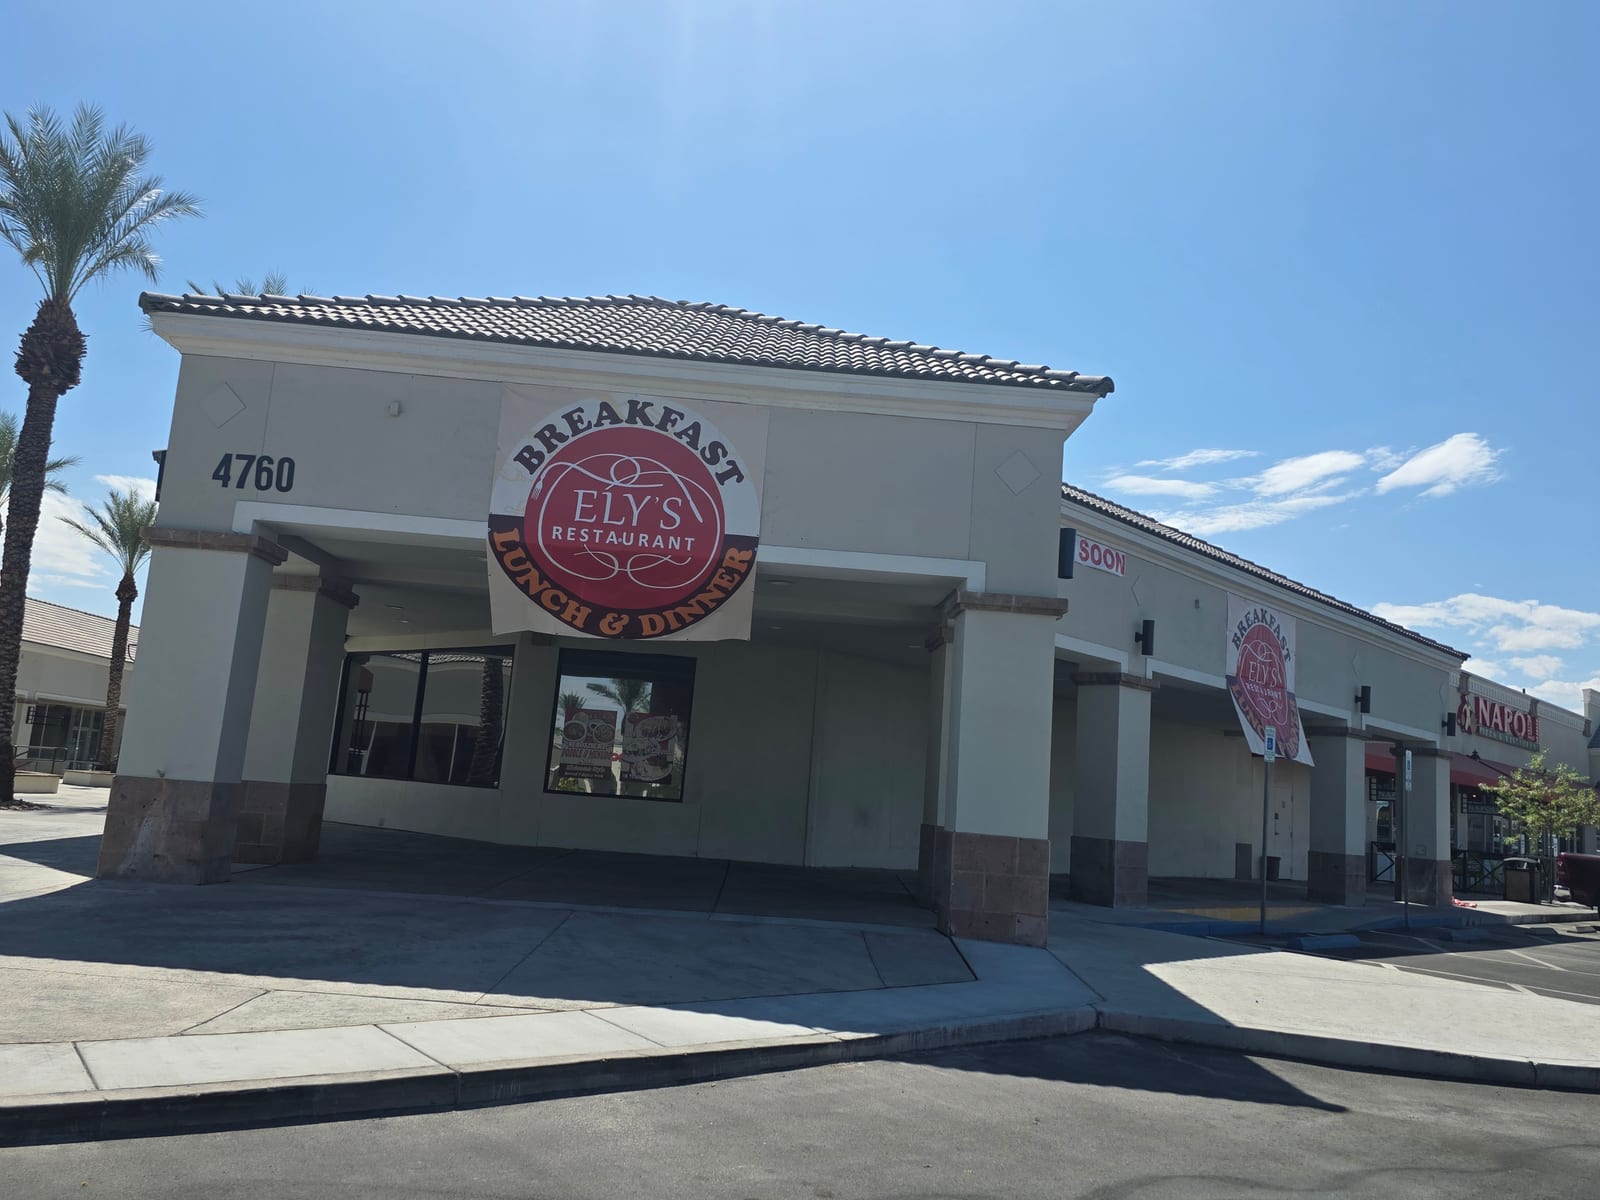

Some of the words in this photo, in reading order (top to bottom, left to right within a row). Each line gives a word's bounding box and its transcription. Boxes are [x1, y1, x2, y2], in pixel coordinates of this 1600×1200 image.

[513, 399, 745, 487] BREAKFAST
[211, 452, 296, 493] 4760
[573, 489, 682, 530] ELY'S
[551, 526, 695, 552] RESTAURANT
[1079, 539, 1126, 576] SOON
[493, 527, 592, 629] LUNCH
[599, 612, 630, 636] &
[638, 546, 753, 637] DINNER
[1232, 608, 1291, 662] BREAKFAST
[1249, 661, 1277, 688] ELY'S
